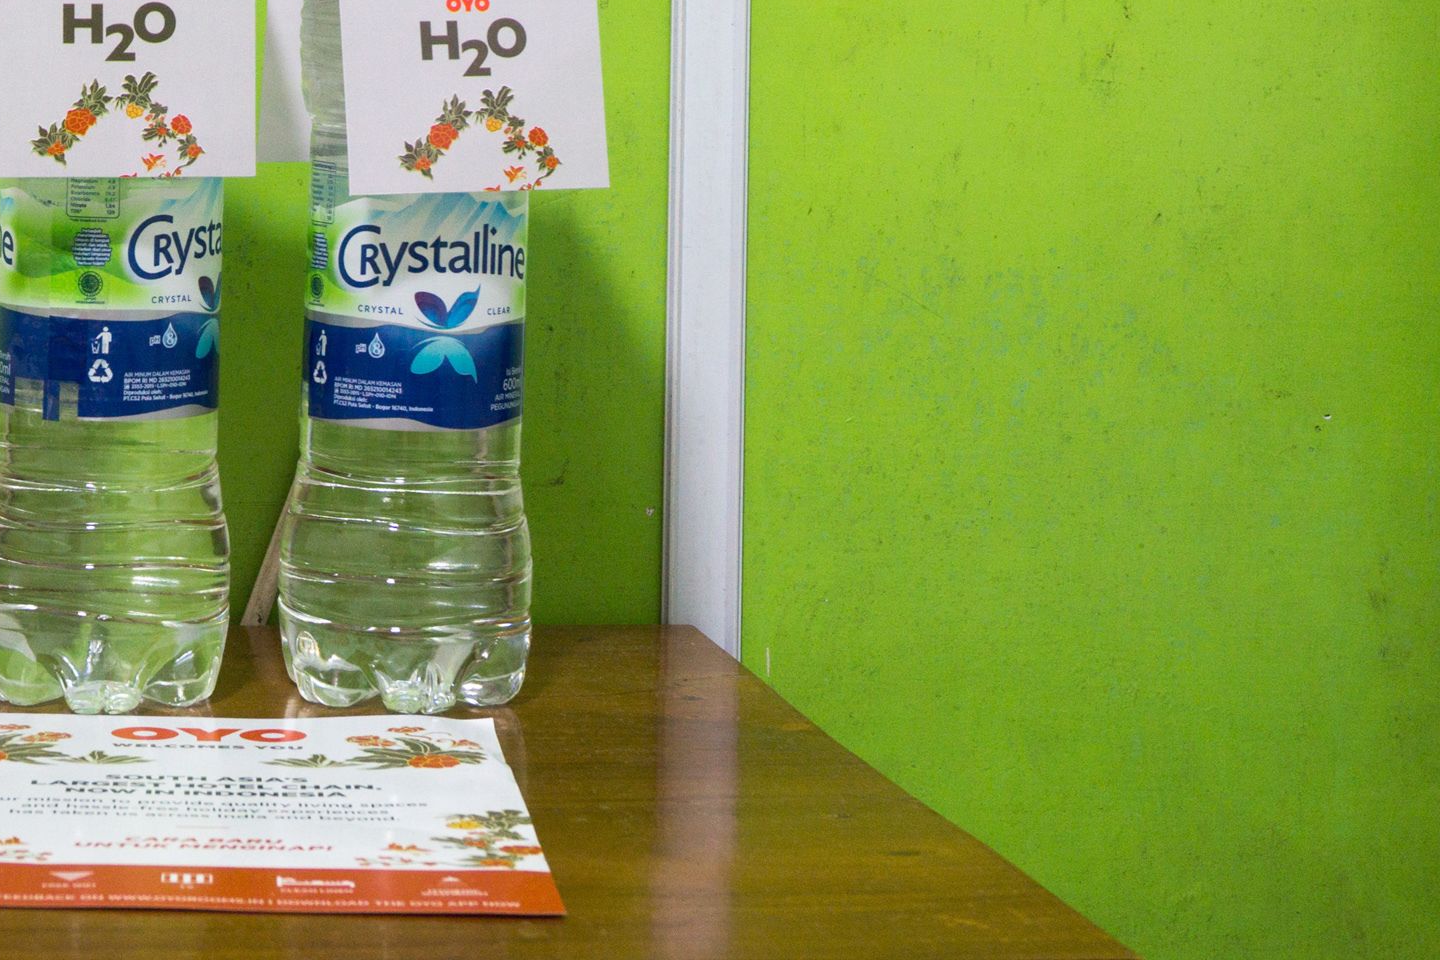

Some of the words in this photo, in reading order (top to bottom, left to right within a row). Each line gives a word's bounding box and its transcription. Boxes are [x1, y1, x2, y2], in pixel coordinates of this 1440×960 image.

[61, 1, 177, 62] H2O
[419, 17, 529, 77] H2O
[151, 294, 193, 305] CRYSTAL
[357, 304, 403, 316] CRYSTAL
[487, 306, 511, 317] CLEAR
[376, 380, 402, 388] KEMASAN
[111, 726, 307, 743] OYO
[113, 742, 245, 750] WELCOMES
[106, 774, 207, 782] SOUTH
[31, 780, 165, 788] LARGEST
[175, 782, 273, 790] HOTEL
